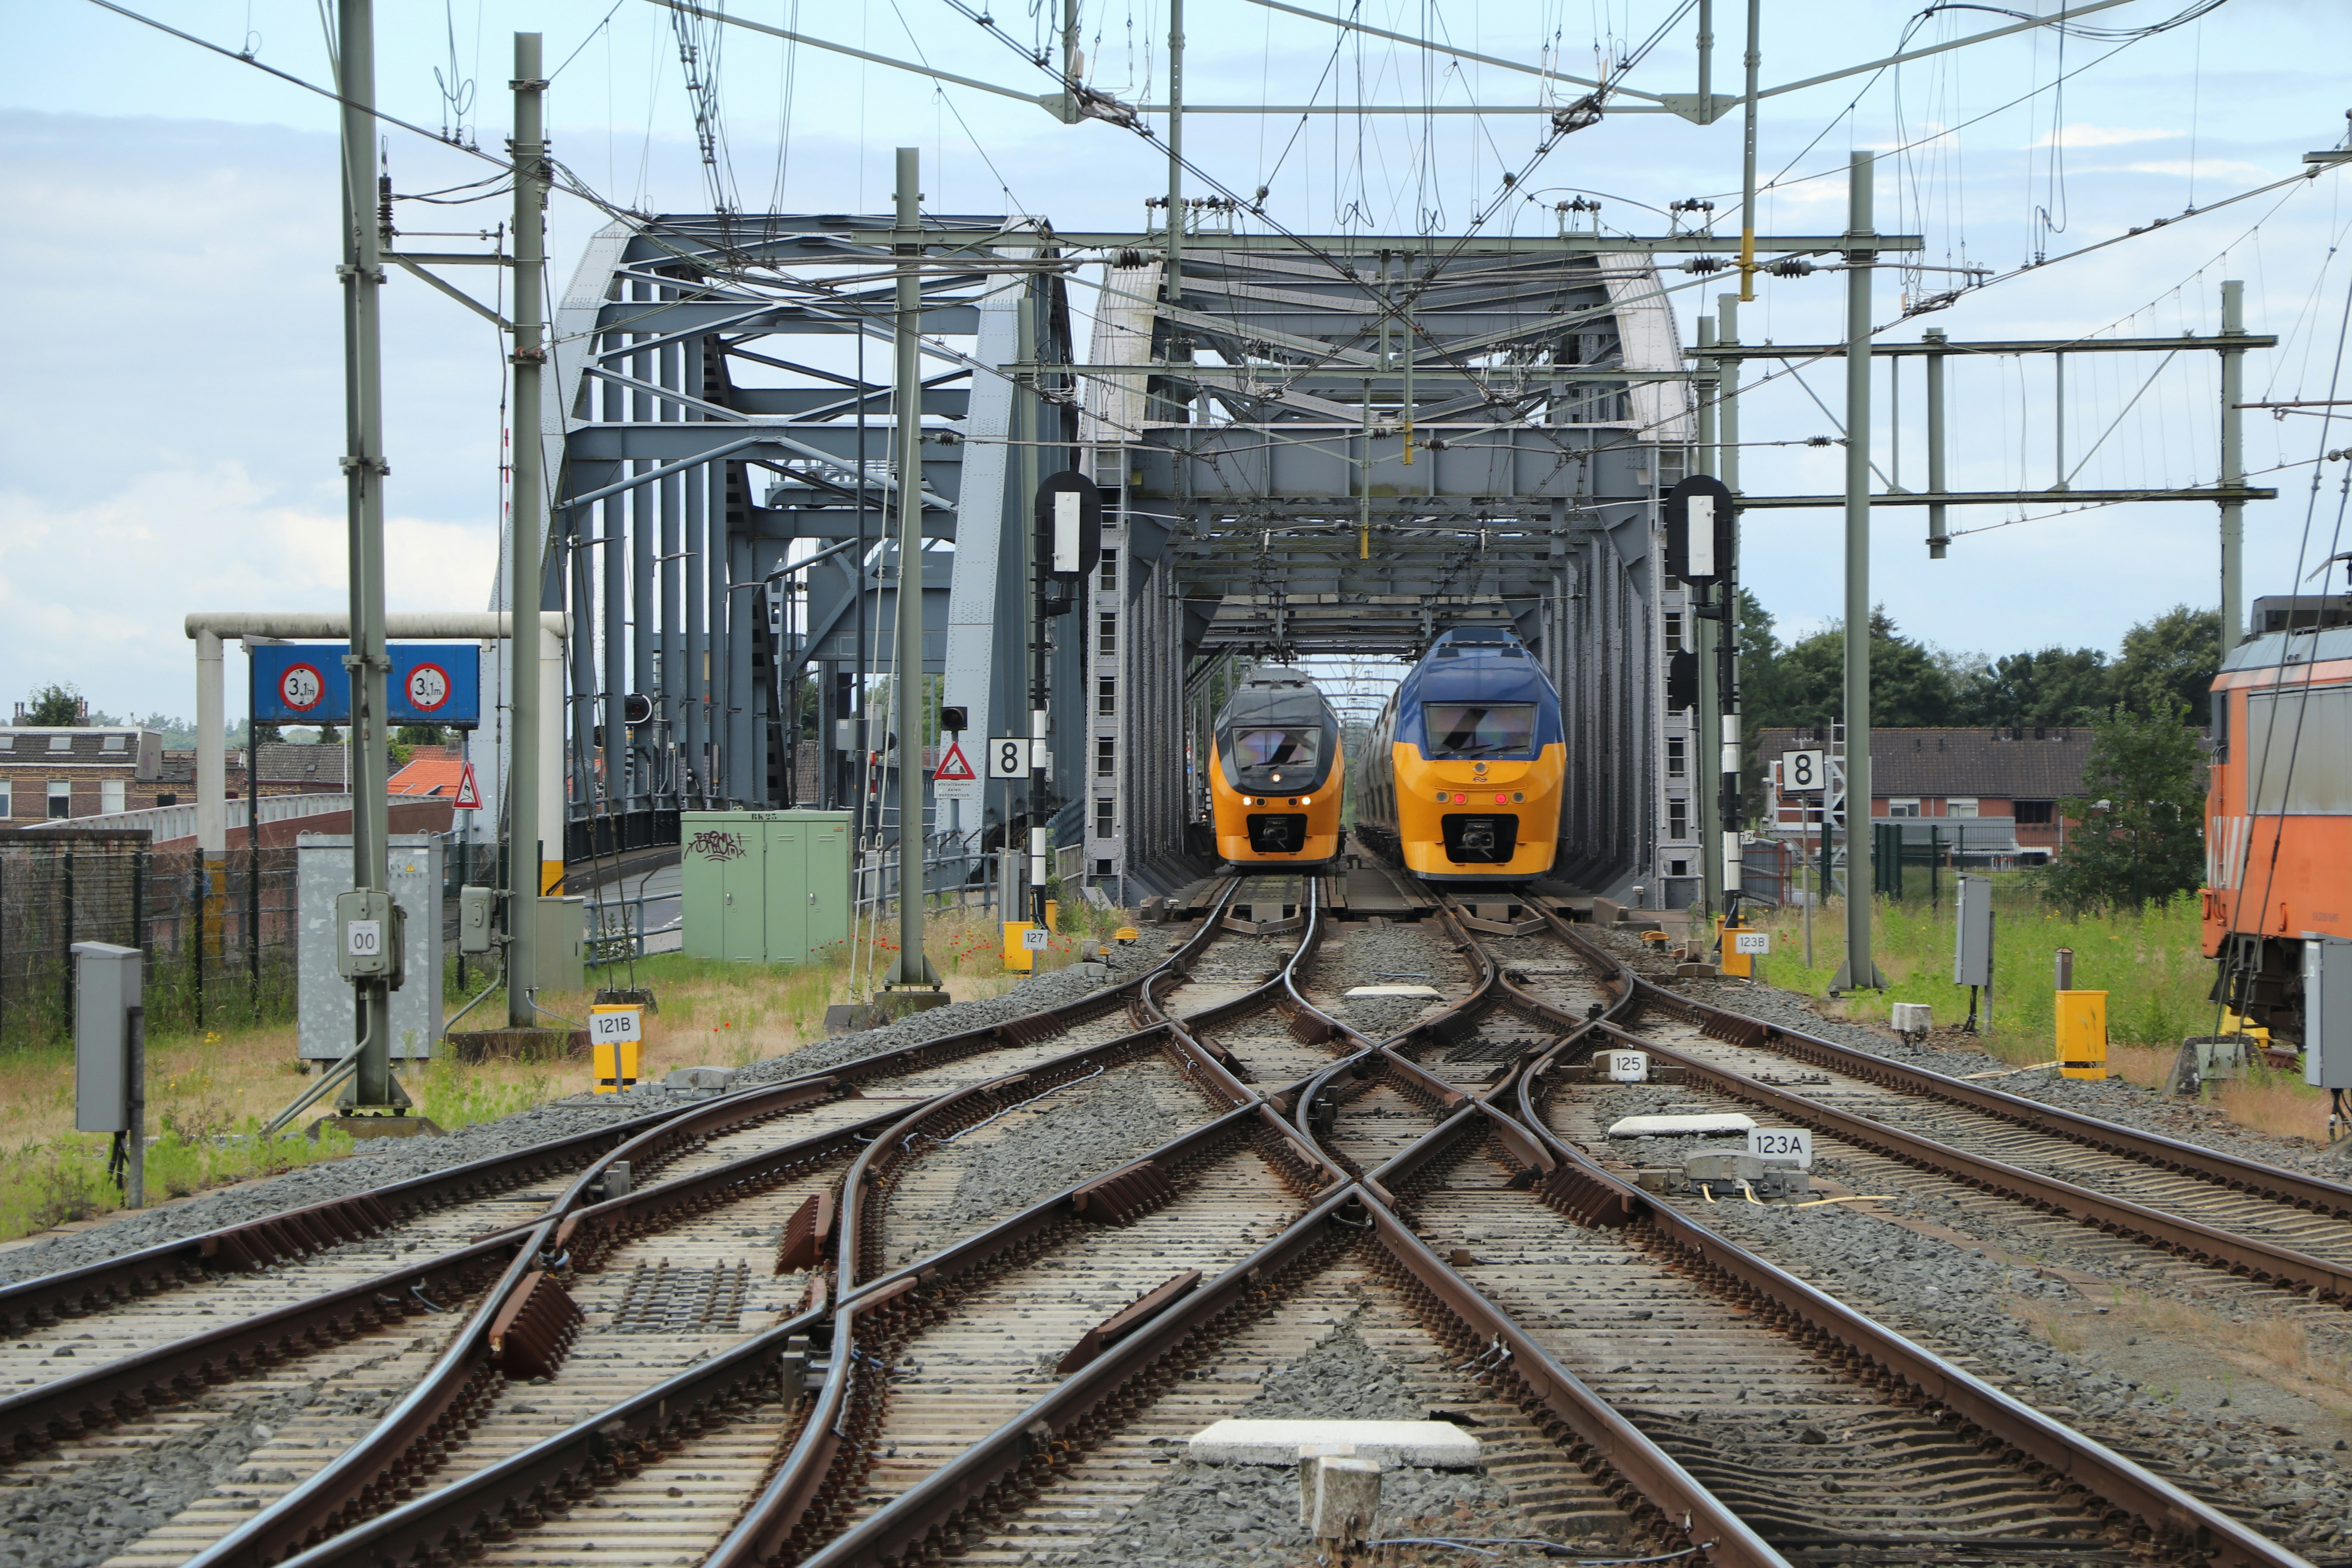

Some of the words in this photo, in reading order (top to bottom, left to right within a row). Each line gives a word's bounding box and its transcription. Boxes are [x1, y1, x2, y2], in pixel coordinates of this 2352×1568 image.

[1001, 742, 1018, 773] 8
[1795, 754, 1812, 785] 8
[354, 933, 374, 949] 00
[1027, 933, 1043, 943] 127
[1740, 937, 1765, 947] 123B
[598, 1017, 630, 1033] 121B
[1616, 1057, 1641, 1071] 125
[1756, 1136, 1803, 1154] 123A
